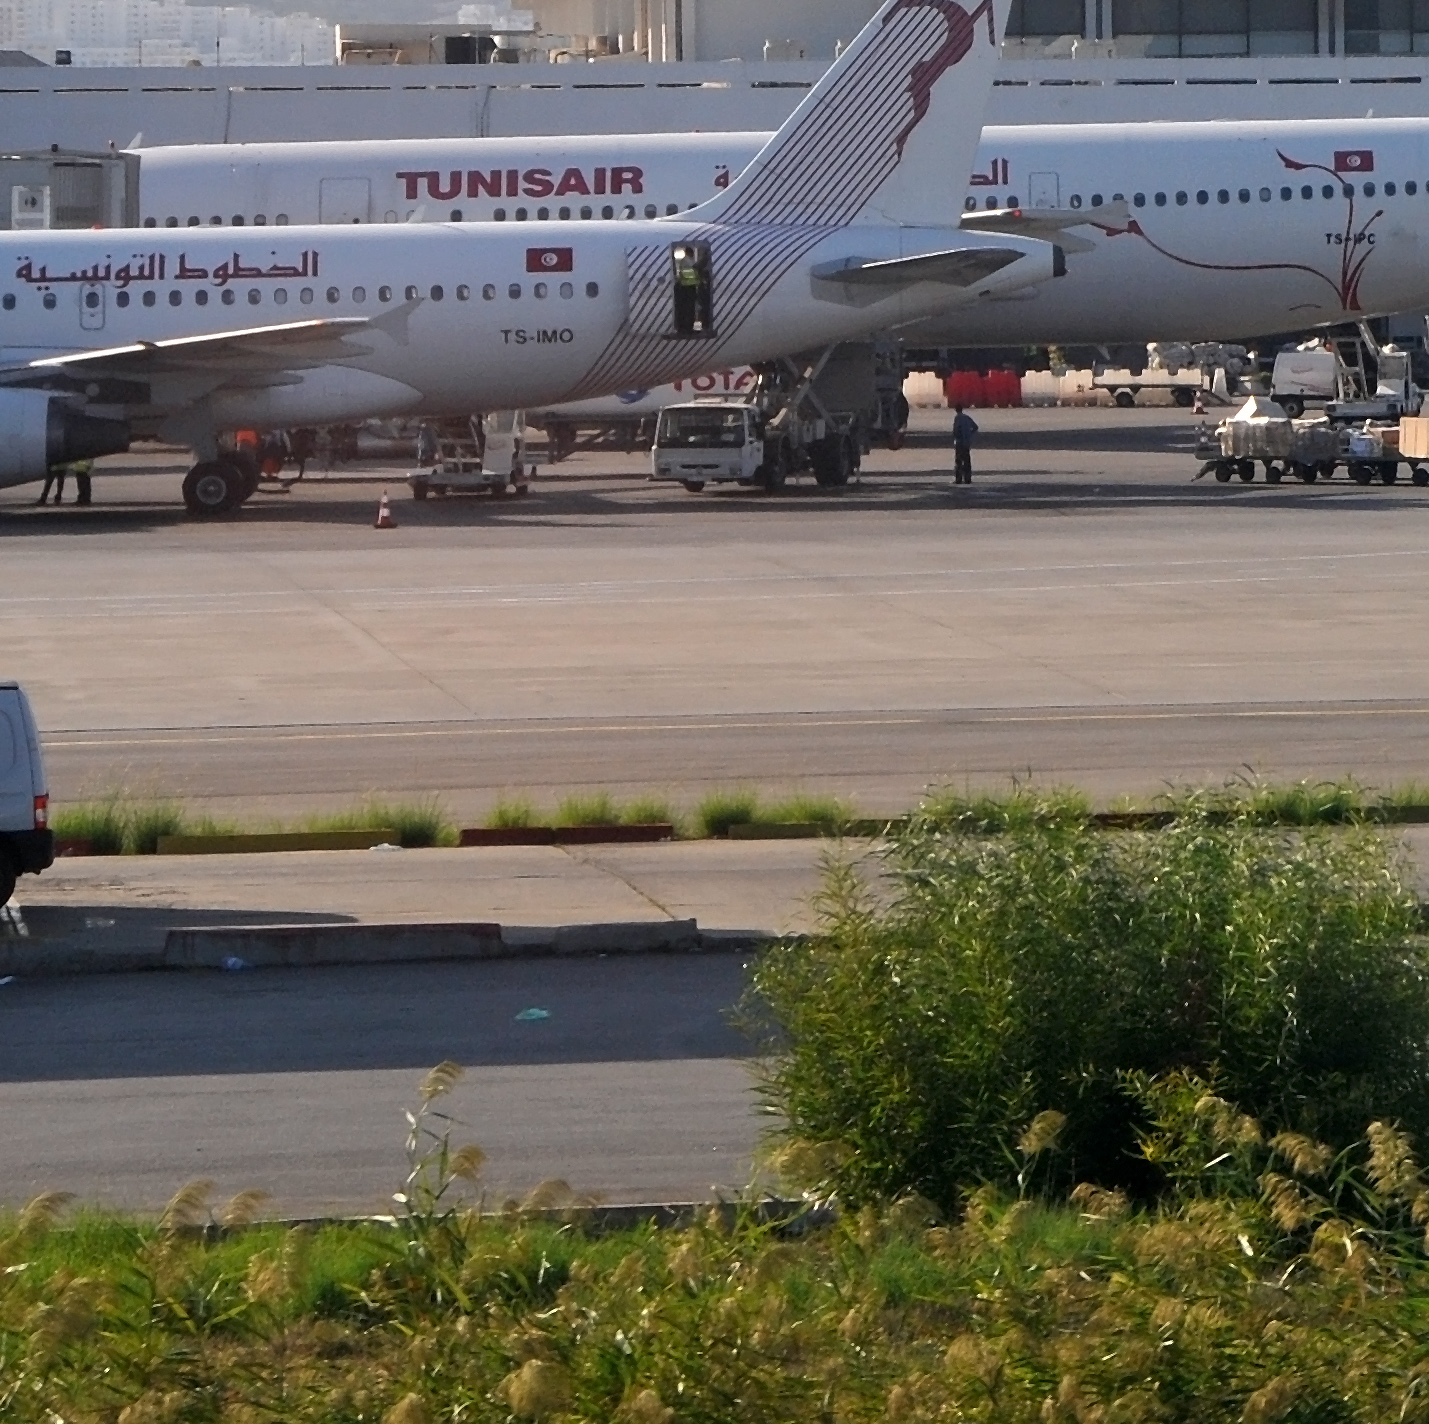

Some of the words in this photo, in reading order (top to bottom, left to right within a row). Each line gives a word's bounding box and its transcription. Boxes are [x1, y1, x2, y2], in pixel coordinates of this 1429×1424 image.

[396, 166, 645, 201] TUNISAIR
[15, 252, 166, 292] التونسية
[173, 249, 320, 287] الخطوط
[500, 327, 575, 345] TS-IMO
